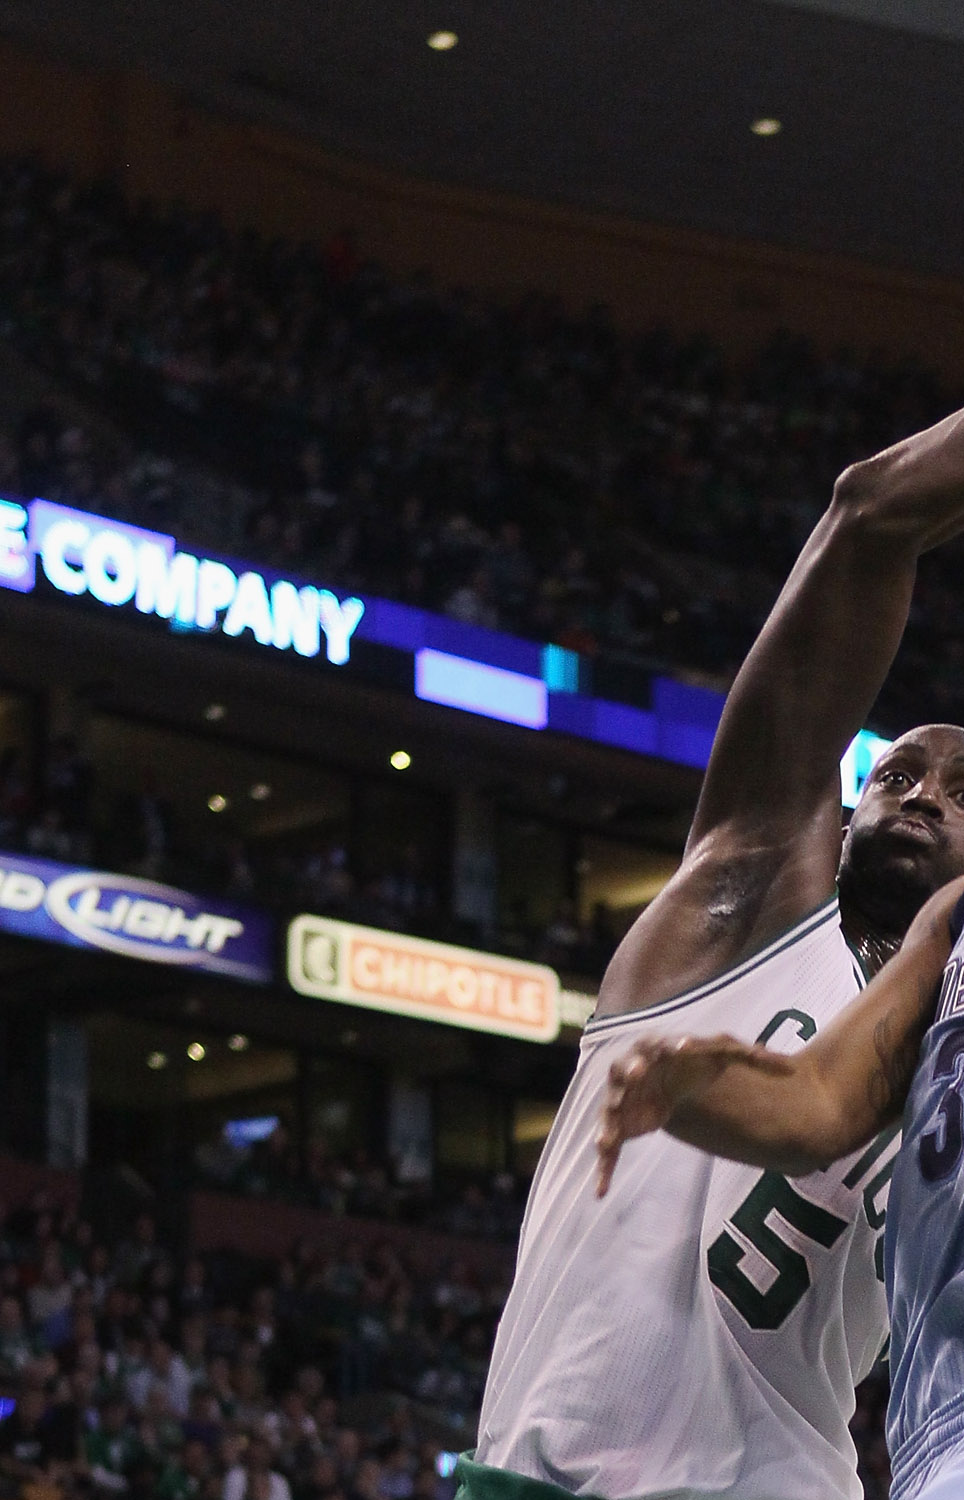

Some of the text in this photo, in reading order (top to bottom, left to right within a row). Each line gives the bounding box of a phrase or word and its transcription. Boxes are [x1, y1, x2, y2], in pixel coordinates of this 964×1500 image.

[42, 520, 365, 666] COMPANY
[74, 886, 244, 953] LIGHT
[352, 946, 546, 1021] CHIPOTLE
[707, 1167, 849, 1330] 5
